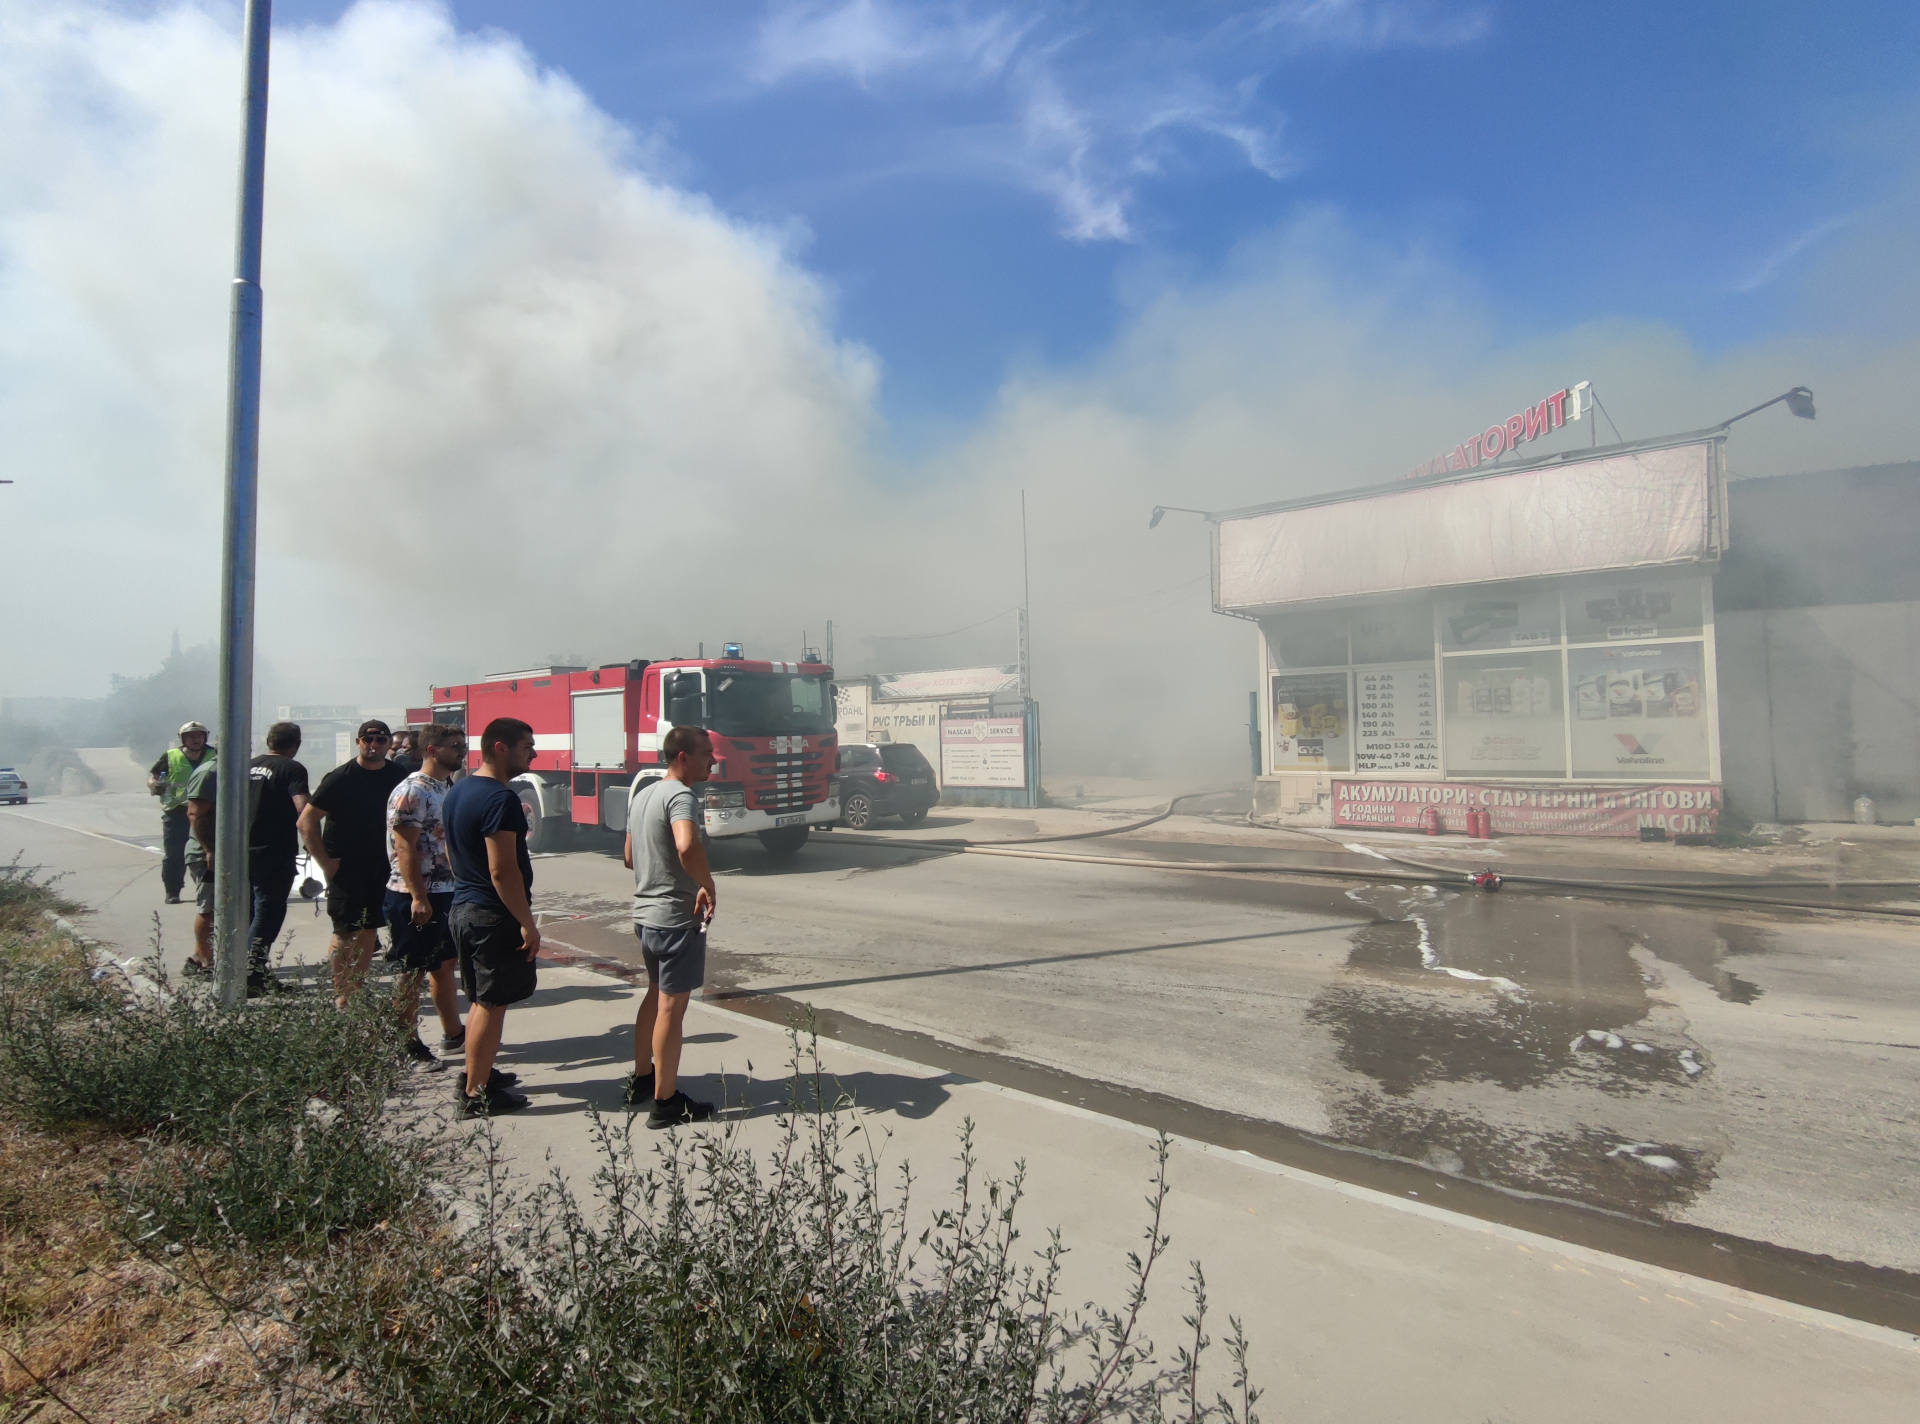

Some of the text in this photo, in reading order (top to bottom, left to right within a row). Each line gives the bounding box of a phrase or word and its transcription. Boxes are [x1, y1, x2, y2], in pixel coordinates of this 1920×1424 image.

[1621, 649, 1662, 657] Valvoline
[932, 678, 963, 687] ХОТЕЛ
[964, 676, 978, 685] ЗА
[838, 706, 864, 719] RDAHL
[872, 716, 890, 727] PVC
[894, 715, 926, 726] ТРЪБИ
[928, 714, 936, 726] И
[769, 739, 810, 750] SCANIA
[1298, 746, 1324, 754] GYS
[1471, 746, 1542, 760] EDGE
[1338, 784, 1476, 806] АКУМУЛАТОРИ:
[1479, 788, 1597, 810] СТАРТЕРНИ
[1624, 790, 1712, 810] ТЯГОВИ
[1339, 803, 1396, 820] 4 ГОДИНИ
[1532, 811, 1610, 821] ДИАГНОСТИКА
[1352, 813, 1396, 823] ГАРАНЦИЯ
[1636, 812, 1712, 834] МАСЛА
[1490, 820, 1586, 832] ВЪНГАРАНЦИОНЕН
[1588, 822, 1630, 832] СЕРВИЗ
